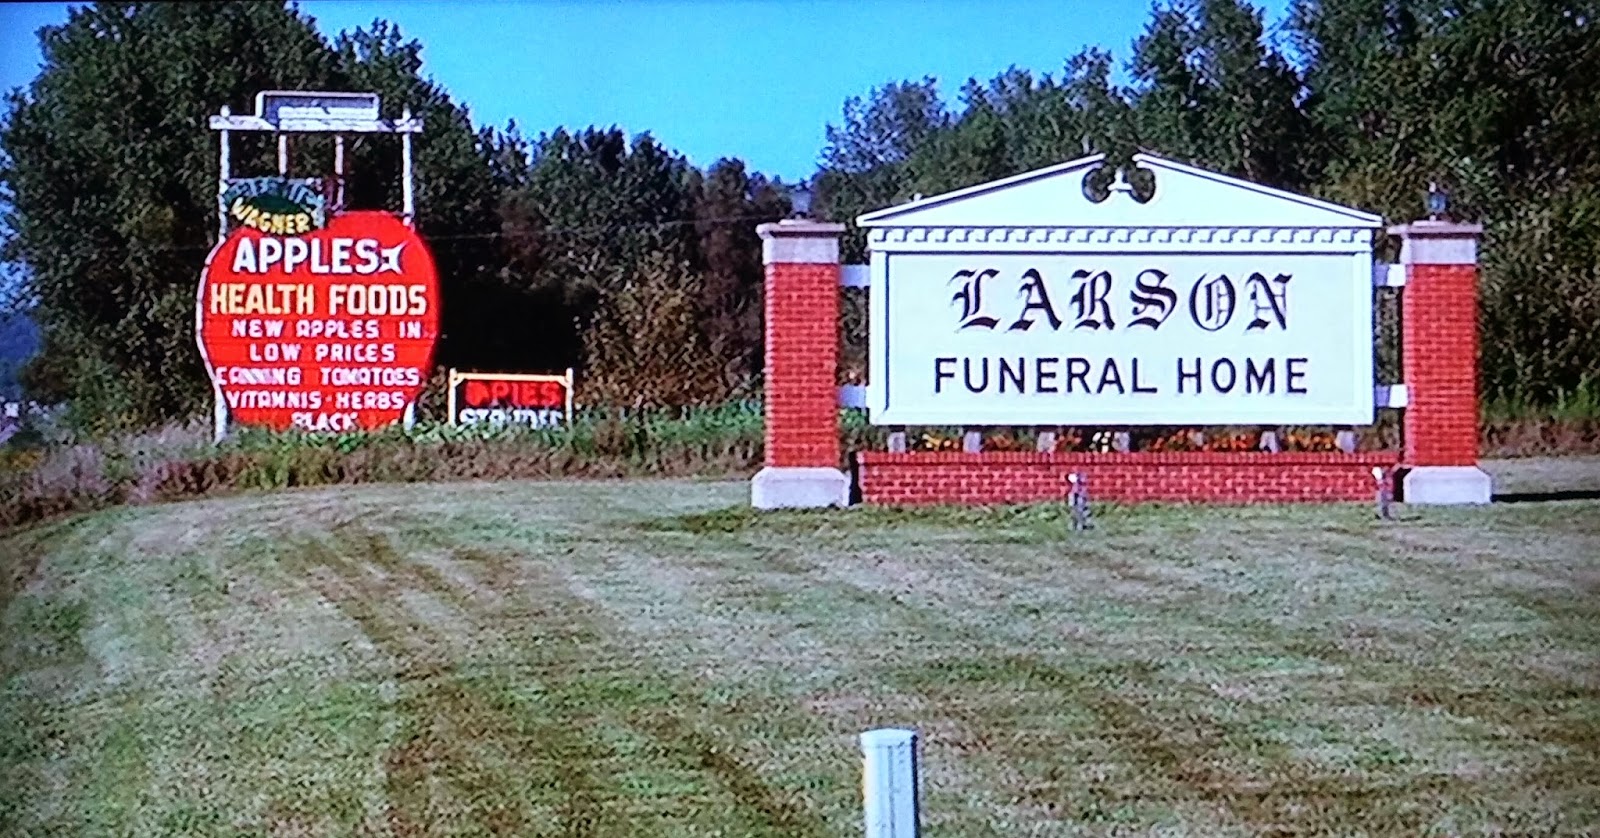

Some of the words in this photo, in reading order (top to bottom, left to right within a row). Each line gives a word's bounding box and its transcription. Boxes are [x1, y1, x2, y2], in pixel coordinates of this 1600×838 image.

[231, 197, 312, 235] WAGNER
[233, 237, 379, 273] APPLES
[211, 283, 314, 315] HEALTH
[330, 284, 427, 315] FOODS
[949, 267, 1293, 332] LARSON
[232, 320, 284, 338] NEW
[296, 320, 379, 338] APPLES
[399, 320, 422, 338] IN
[250, 343, 302, 361] LOW
[315, 343, 395, 362] PRICES
[320, 367, 420, 386] TOMATOES
[935, 357, 1158, 394] FUNERAL
[1178, 357, 1309, 394] HOME
[336, 391, 405, 409] HERBS
[492, 381, 561, 405] PIES
